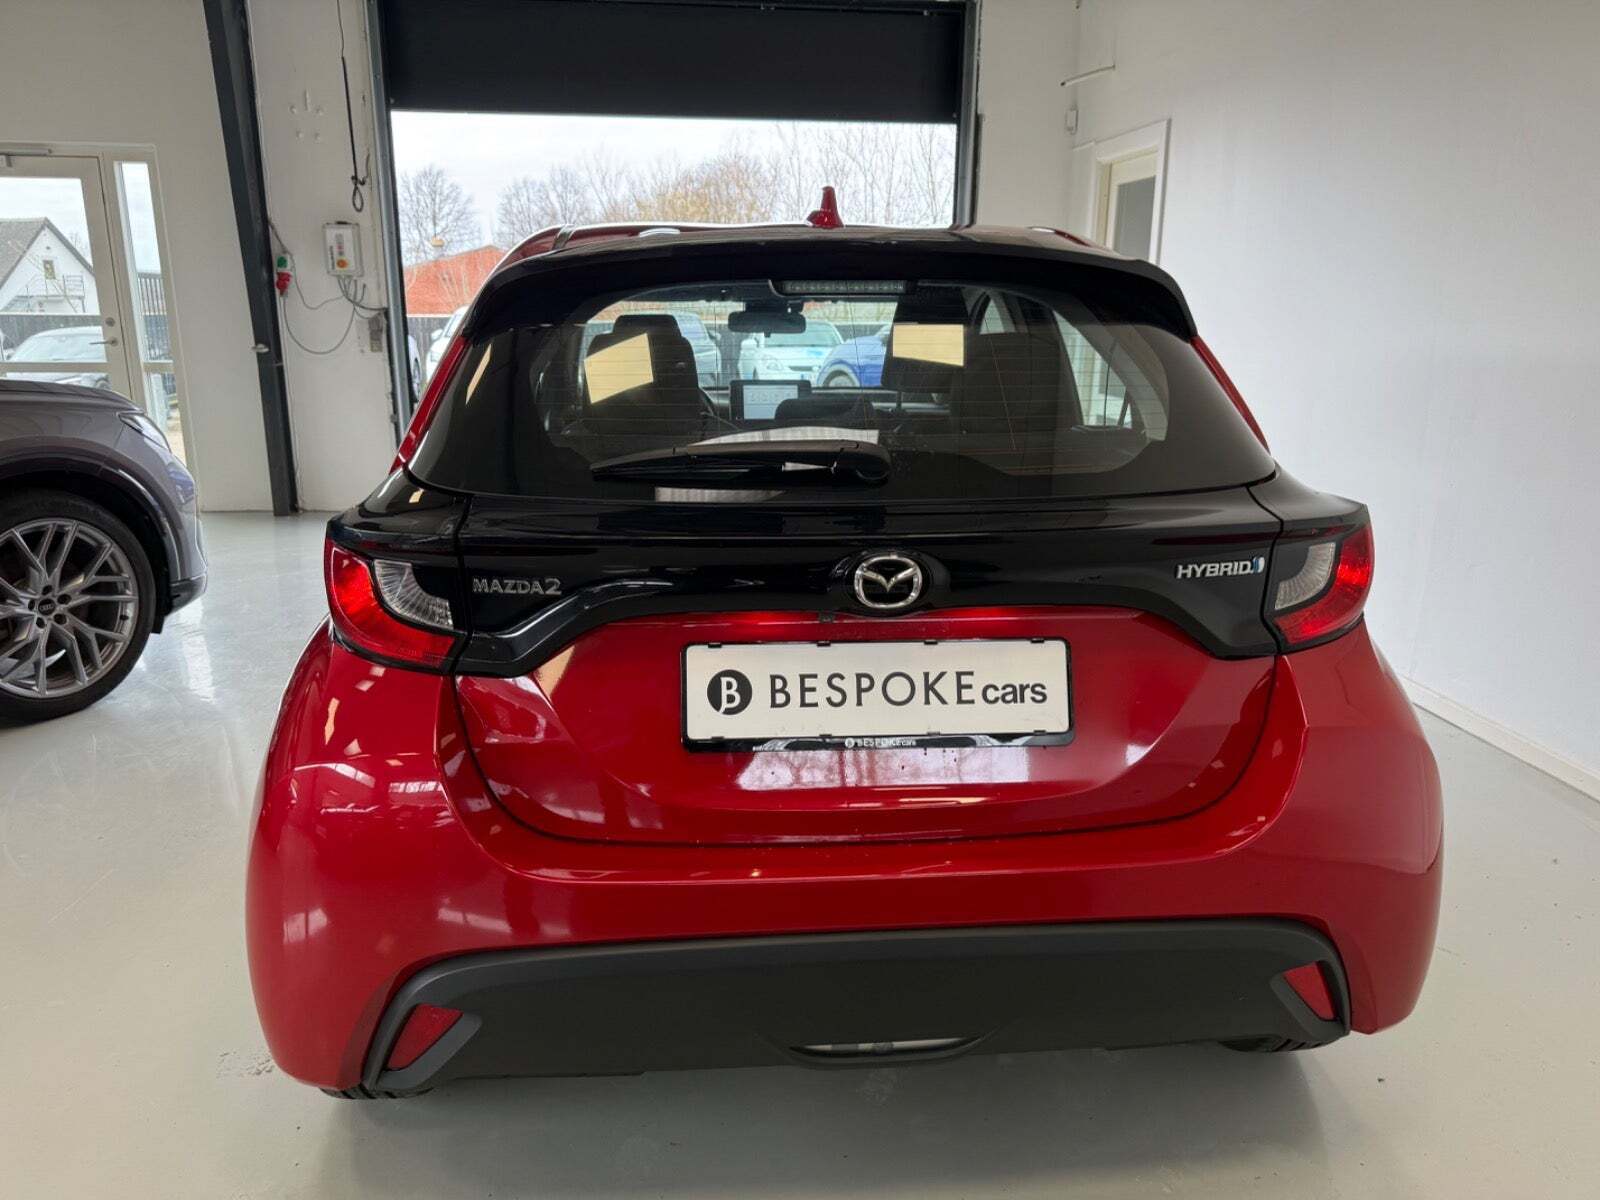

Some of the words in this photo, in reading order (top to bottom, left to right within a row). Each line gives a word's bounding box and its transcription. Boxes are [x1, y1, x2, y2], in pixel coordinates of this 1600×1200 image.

[1176, 560, 1253, 579] HYBRID
[472, 578, 562, 595] MAZDA2
[769, 671, 976, 709] BESPOKE
[981, 681, 1048, 704] cars
